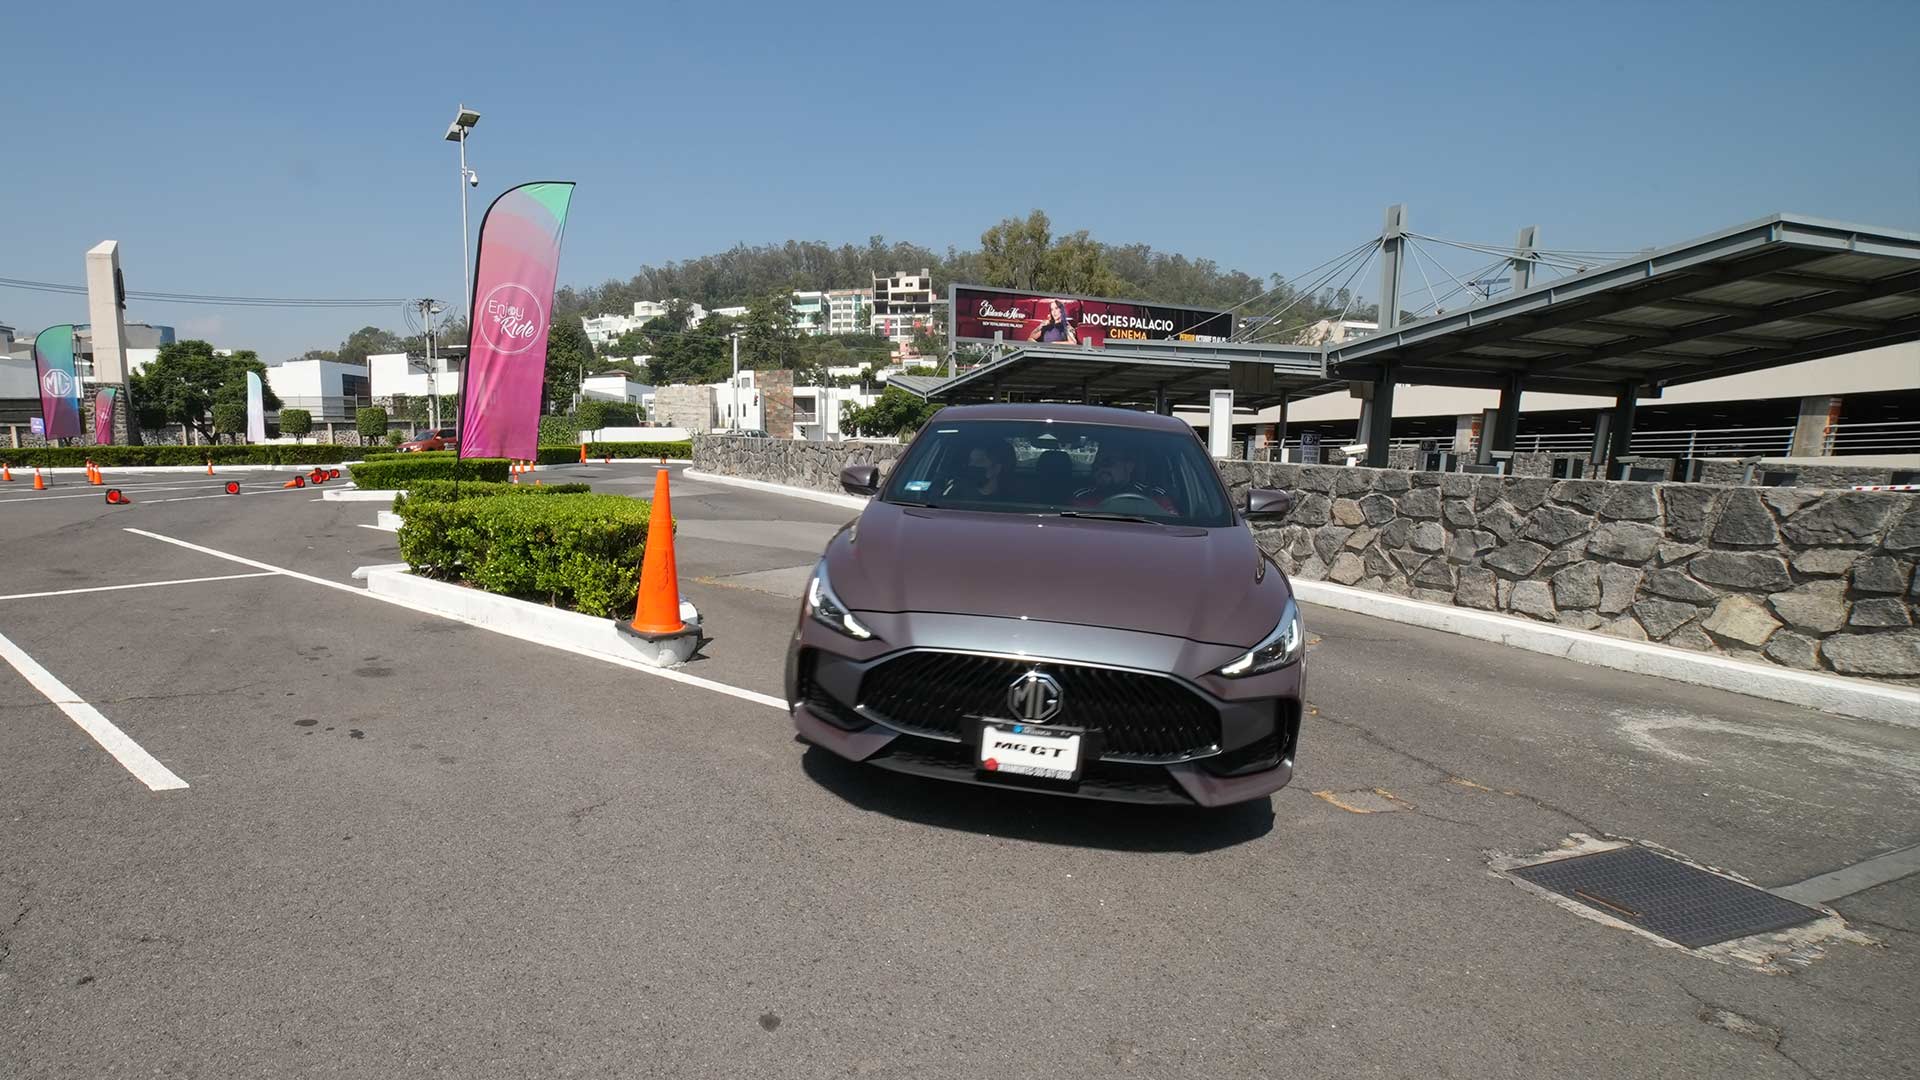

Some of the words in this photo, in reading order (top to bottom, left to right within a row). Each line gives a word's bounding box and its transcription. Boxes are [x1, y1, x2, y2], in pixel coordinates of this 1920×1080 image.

[488, 299, 524, 321] Enjoy
[500, 316, 535, 339] Ride
[1082, 313, 1128, 327] NOCHES
[1130, 317, 1174, 331] PALACIO
[1110, 328, 1147, 340] CINEMA
[45, 370, 71, 396] MG
[1013, 677, 1059, 720] MG
[994, 741, 1027, 751] MG
[1030, 745, 1068, 758] GT
